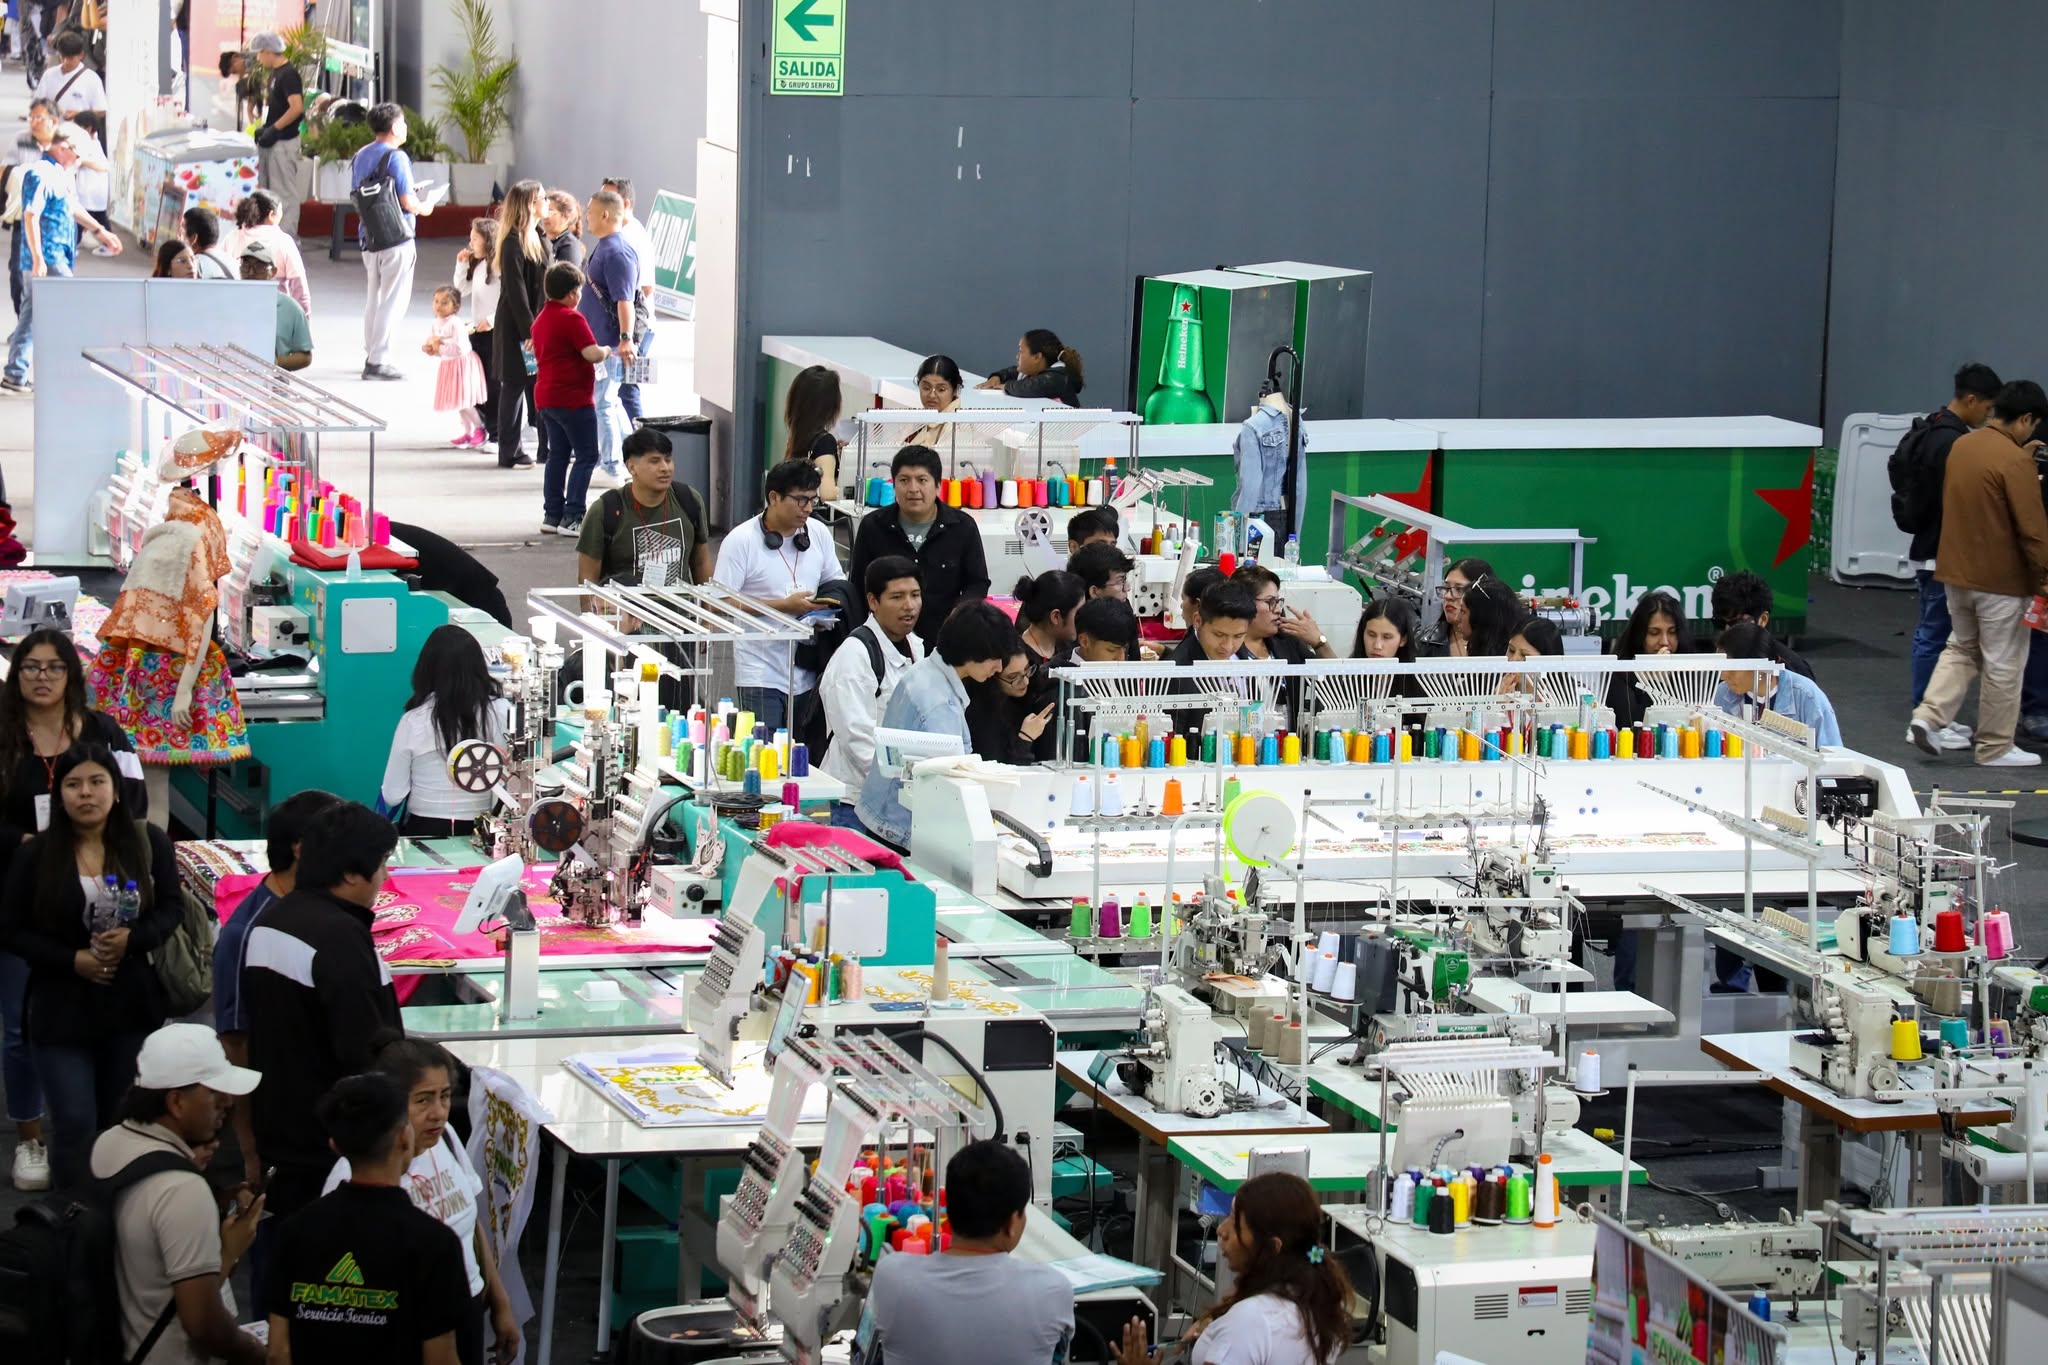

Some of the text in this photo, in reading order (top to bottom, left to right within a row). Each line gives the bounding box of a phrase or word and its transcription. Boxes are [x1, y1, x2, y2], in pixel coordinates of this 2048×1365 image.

[779, 60, 836, 77] SALIDA
[788, 81, 835, 90] GRUPO SERPRO
[1177, 317, 1189, 368] Heineken
[290, 1281, 399, 1310] FAMATEX
[296, 1303, 387, 1326] Servicio Tecnico
